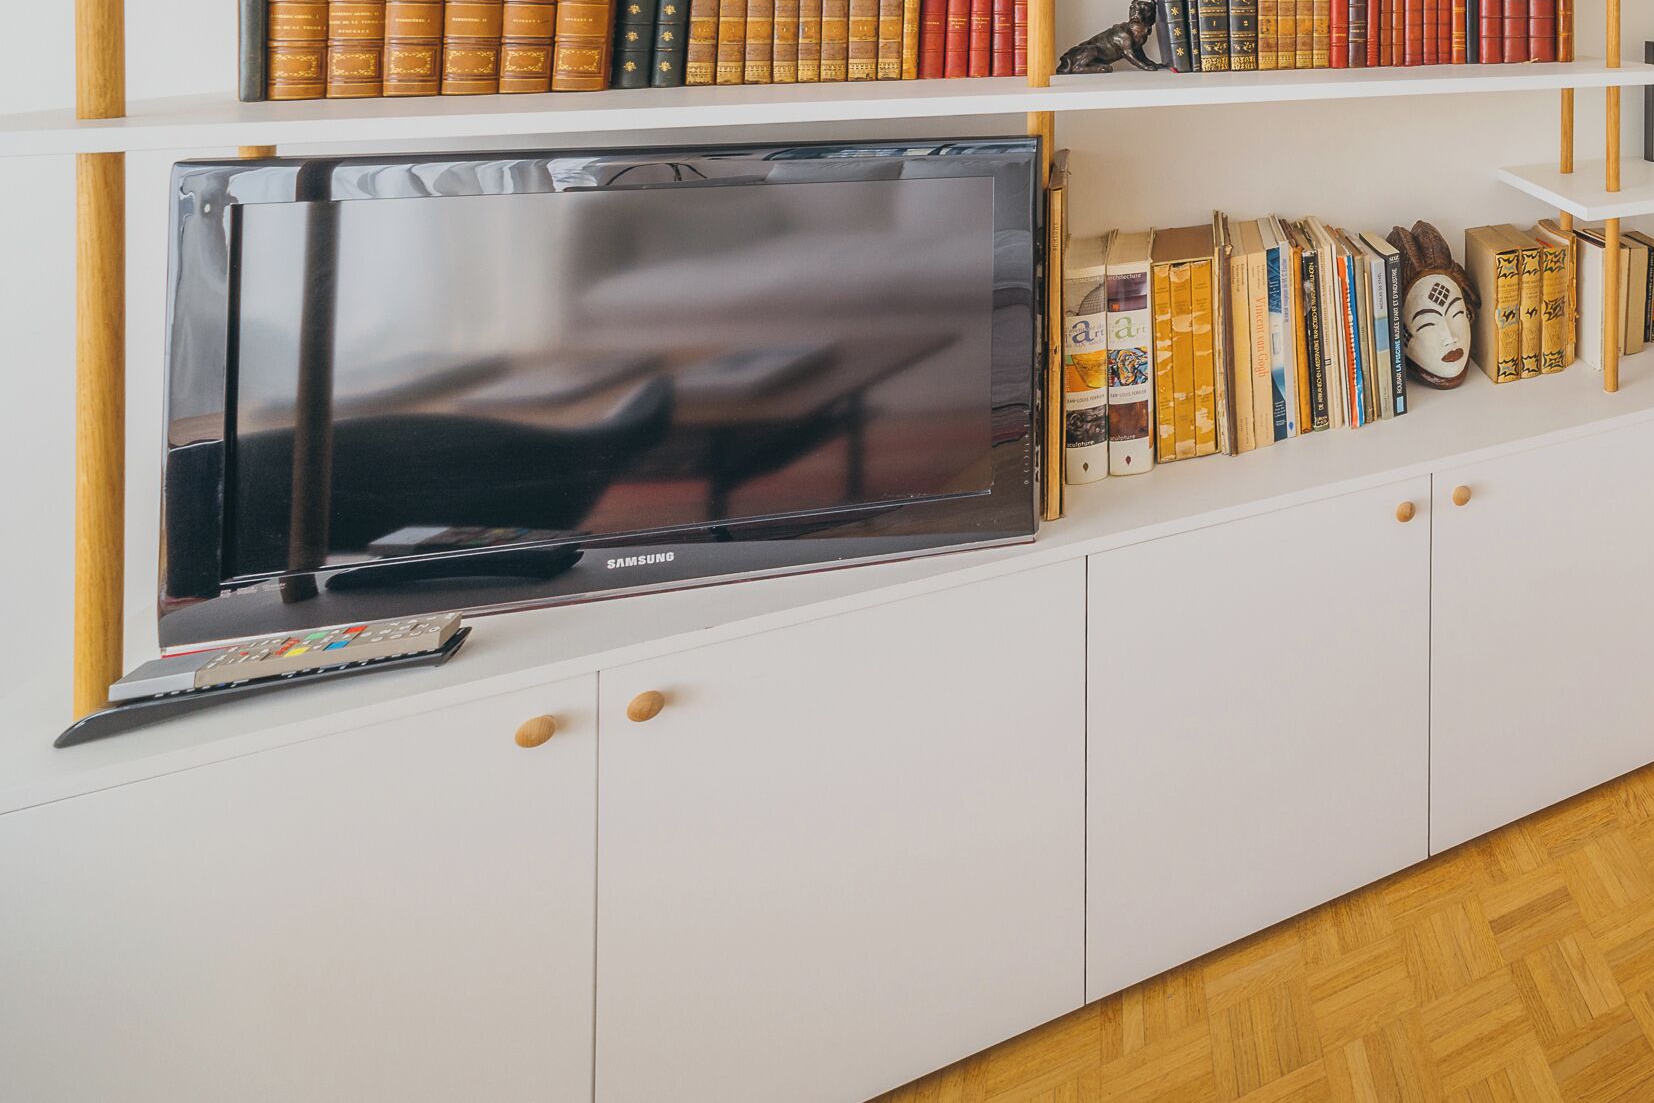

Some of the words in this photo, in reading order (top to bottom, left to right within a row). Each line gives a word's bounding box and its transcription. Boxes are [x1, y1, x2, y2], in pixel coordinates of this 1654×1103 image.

[1390, 268, 1398, 299] D'INDUSTRIE
[1255, 296, 1266, 331] Vincent
[1256, 351, 1269, 378] Gogh
[1393, 340, 1401, 364] PISCINE
[1067, 440, 1095, 448] sculpture
[607, 552, 675, 569] SAMSUNG
